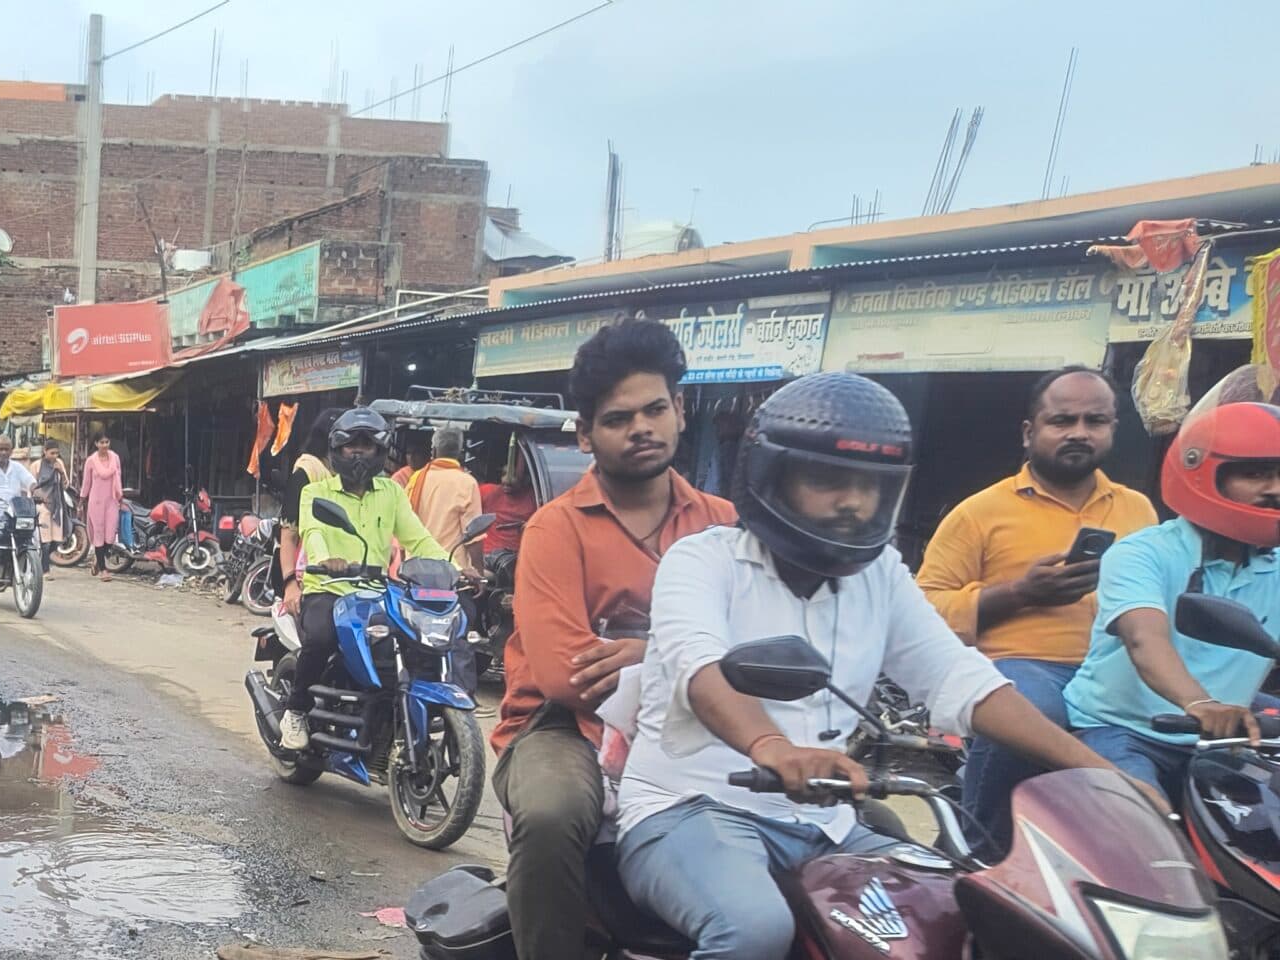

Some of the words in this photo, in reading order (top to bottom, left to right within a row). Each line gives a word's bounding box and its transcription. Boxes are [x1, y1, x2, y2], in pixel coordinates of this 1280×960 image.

[850, 289, 890, 314] जनता
[991, 272, 1056, 303] मेडिकल
[1056, 270, 1095, 301] हॉल
[787, 313, 825, 349] दुकान
